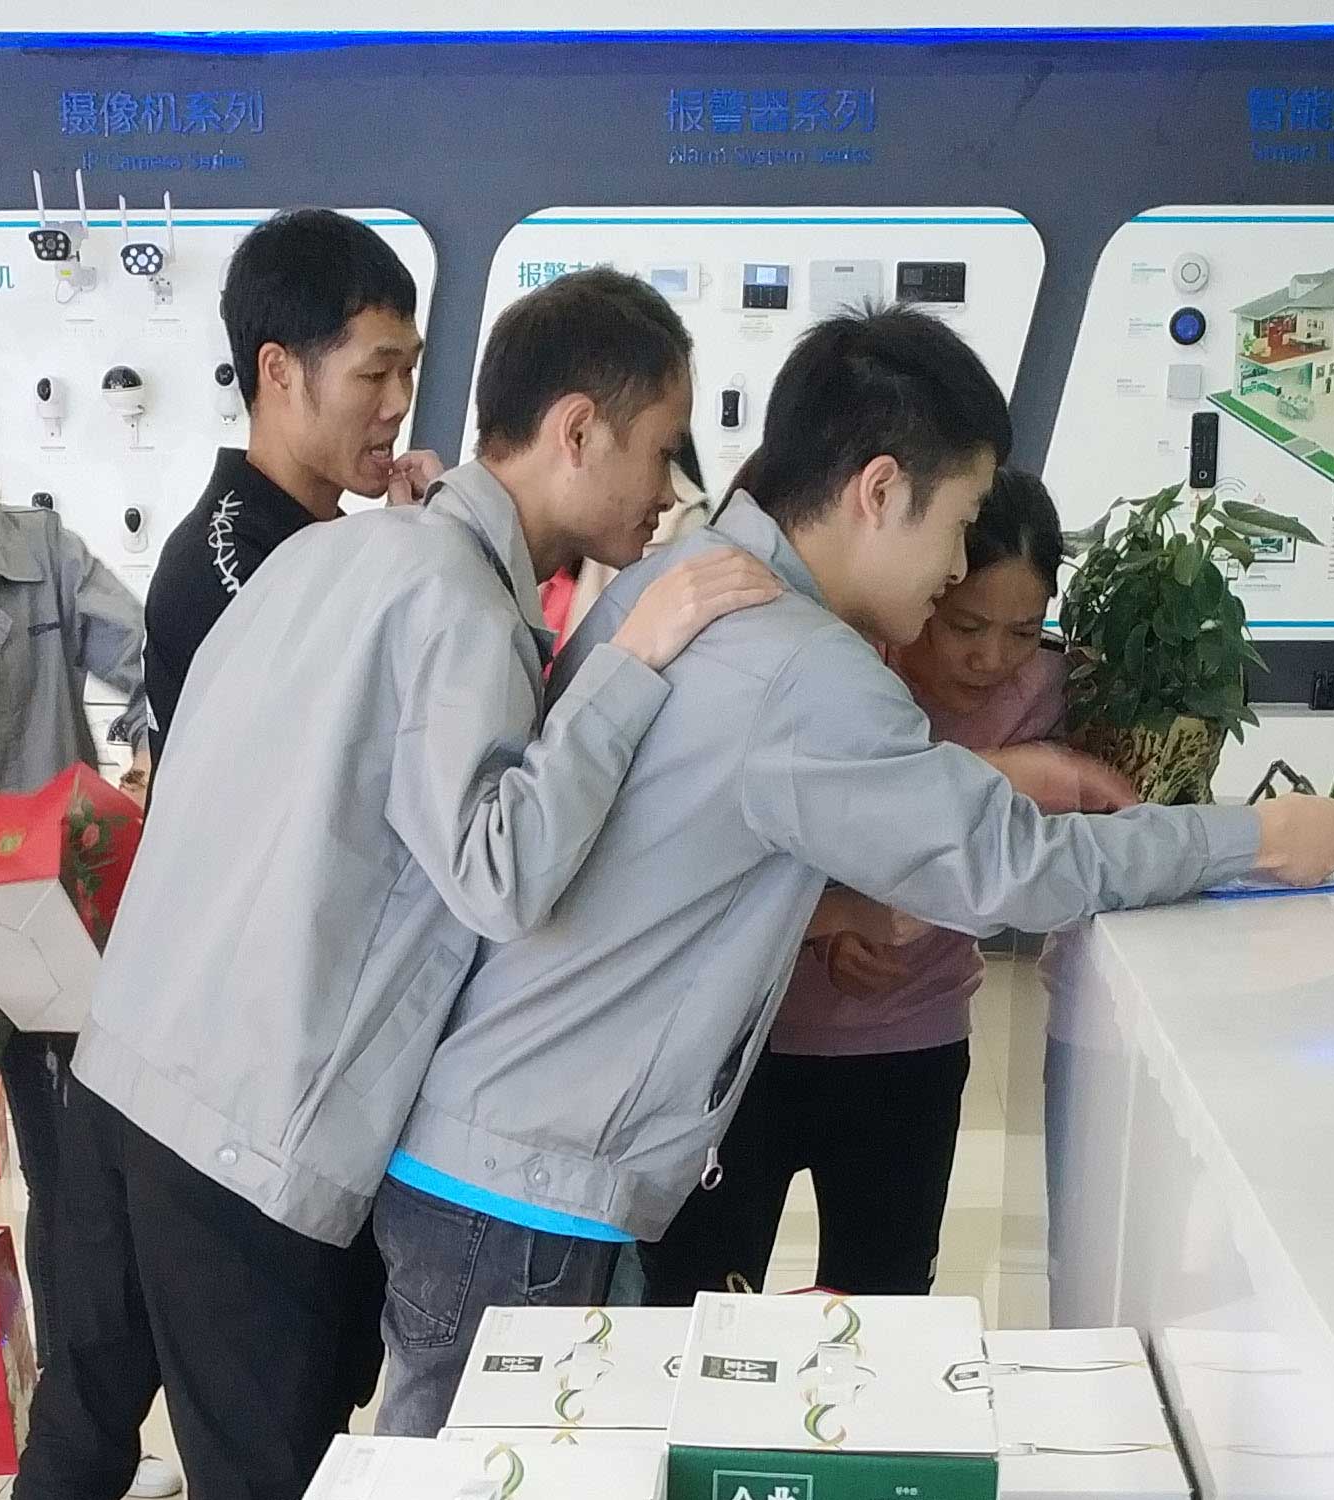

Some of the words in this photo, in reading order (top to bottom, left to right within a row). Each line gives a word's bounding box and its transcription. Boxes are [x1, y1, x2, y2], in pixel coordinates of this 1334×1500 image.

[58, 90, 267, 137] 摄像机系列
[668, 88, 877, 134] 报警器系列
[669, 145, 727, 164] Alarm
